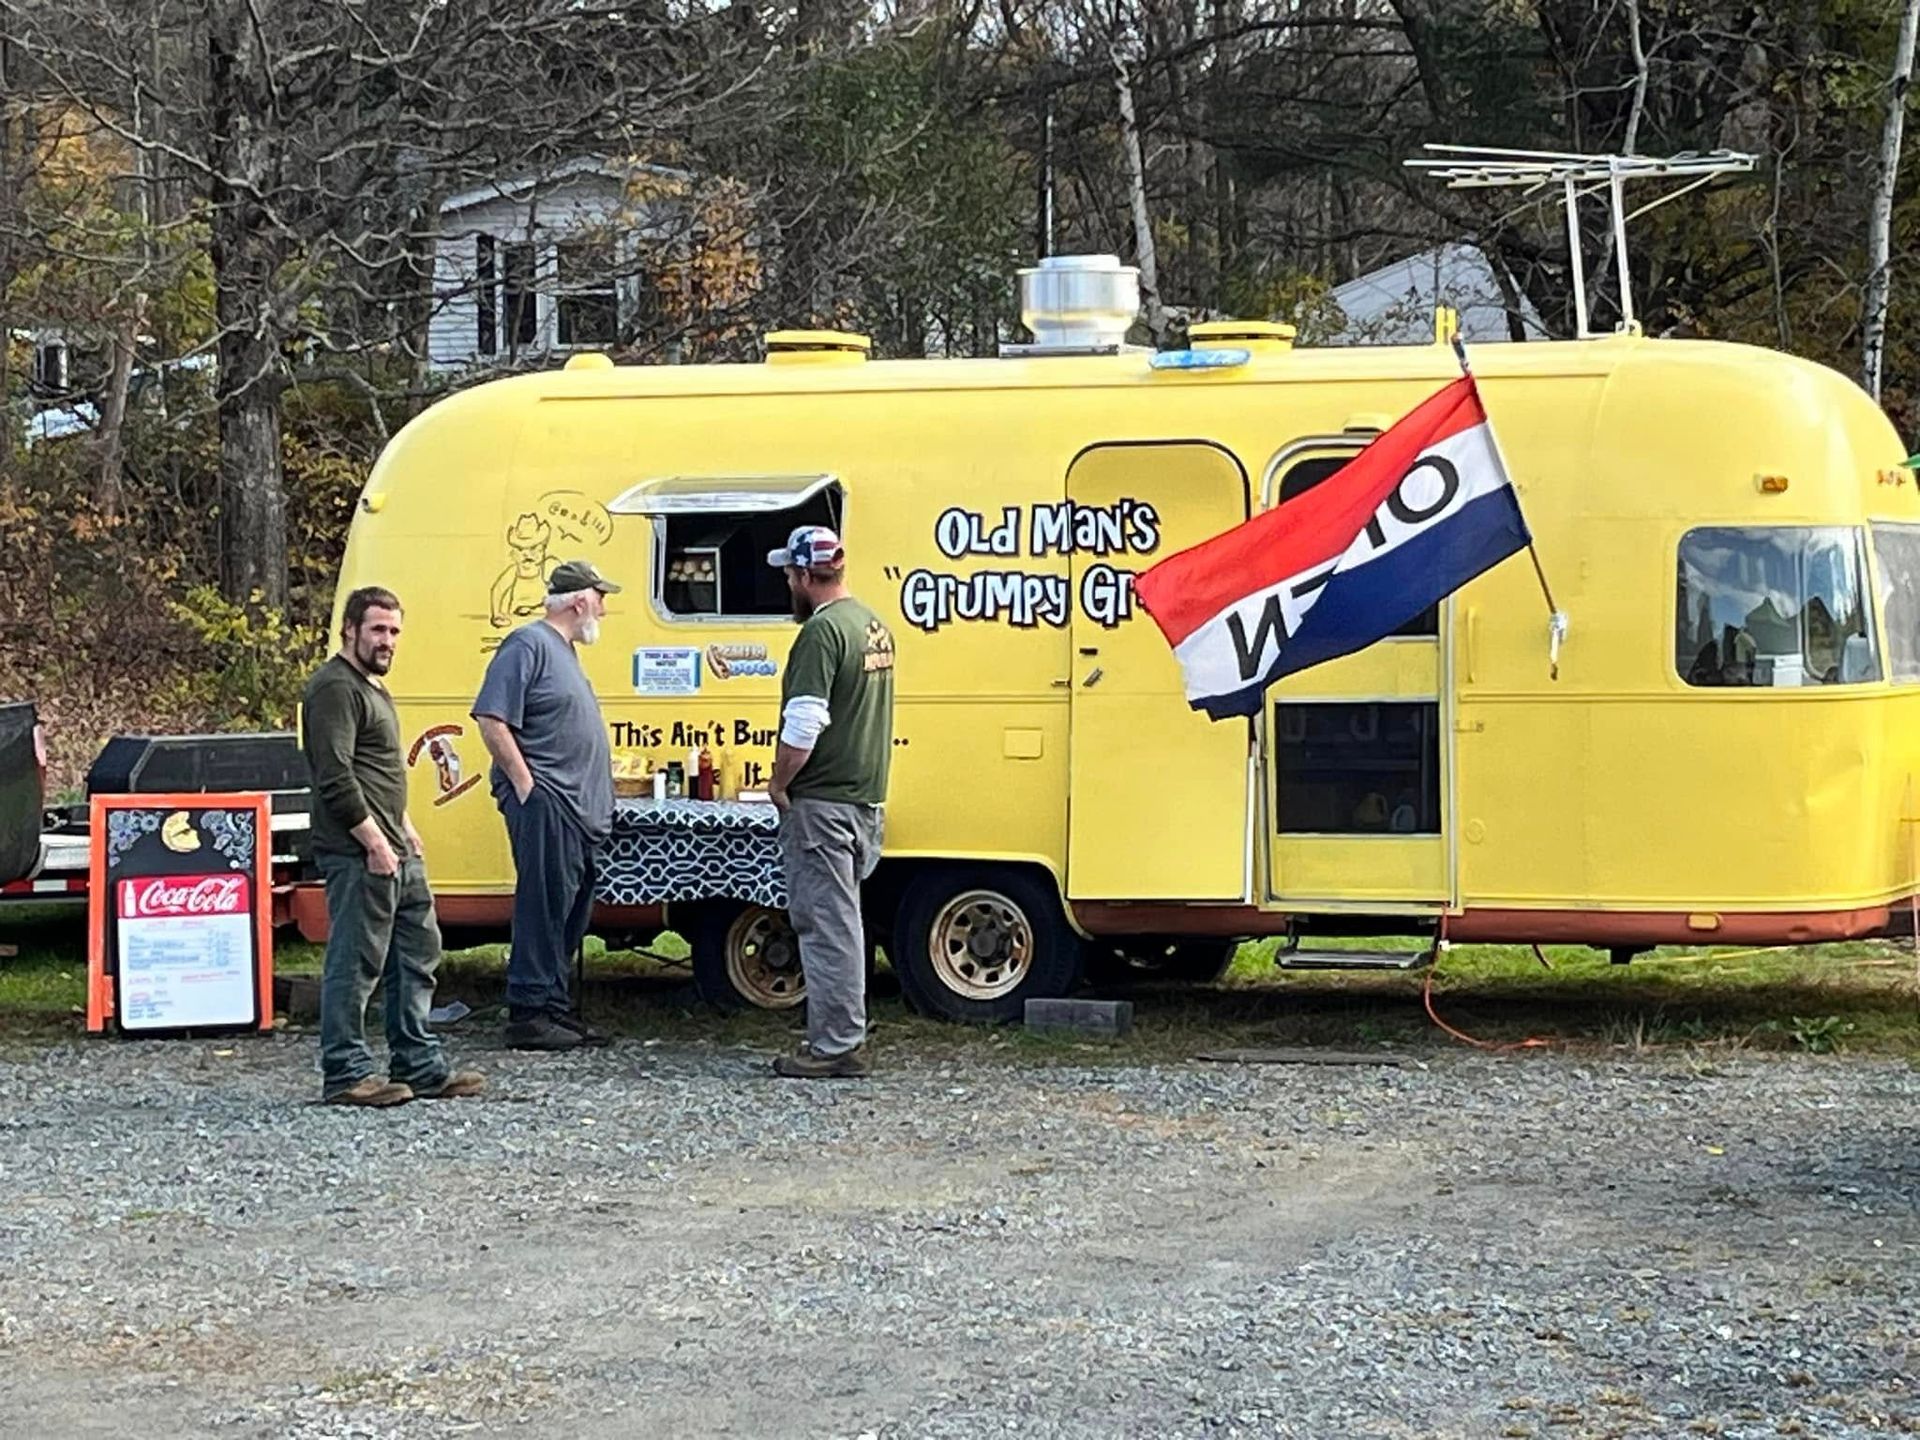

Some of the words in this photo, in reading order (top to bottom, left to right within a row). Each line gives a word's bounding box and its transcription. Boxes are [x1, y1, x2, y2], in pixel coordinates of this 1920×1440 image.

[1080, 563, 1144, 629] Gr
[610, 720, 663, 748] This
[670, 719, 726, 748] Ain't
[734, 719, 777, 748] Bur
[139, 876, 246, 913] Coca-Cola
